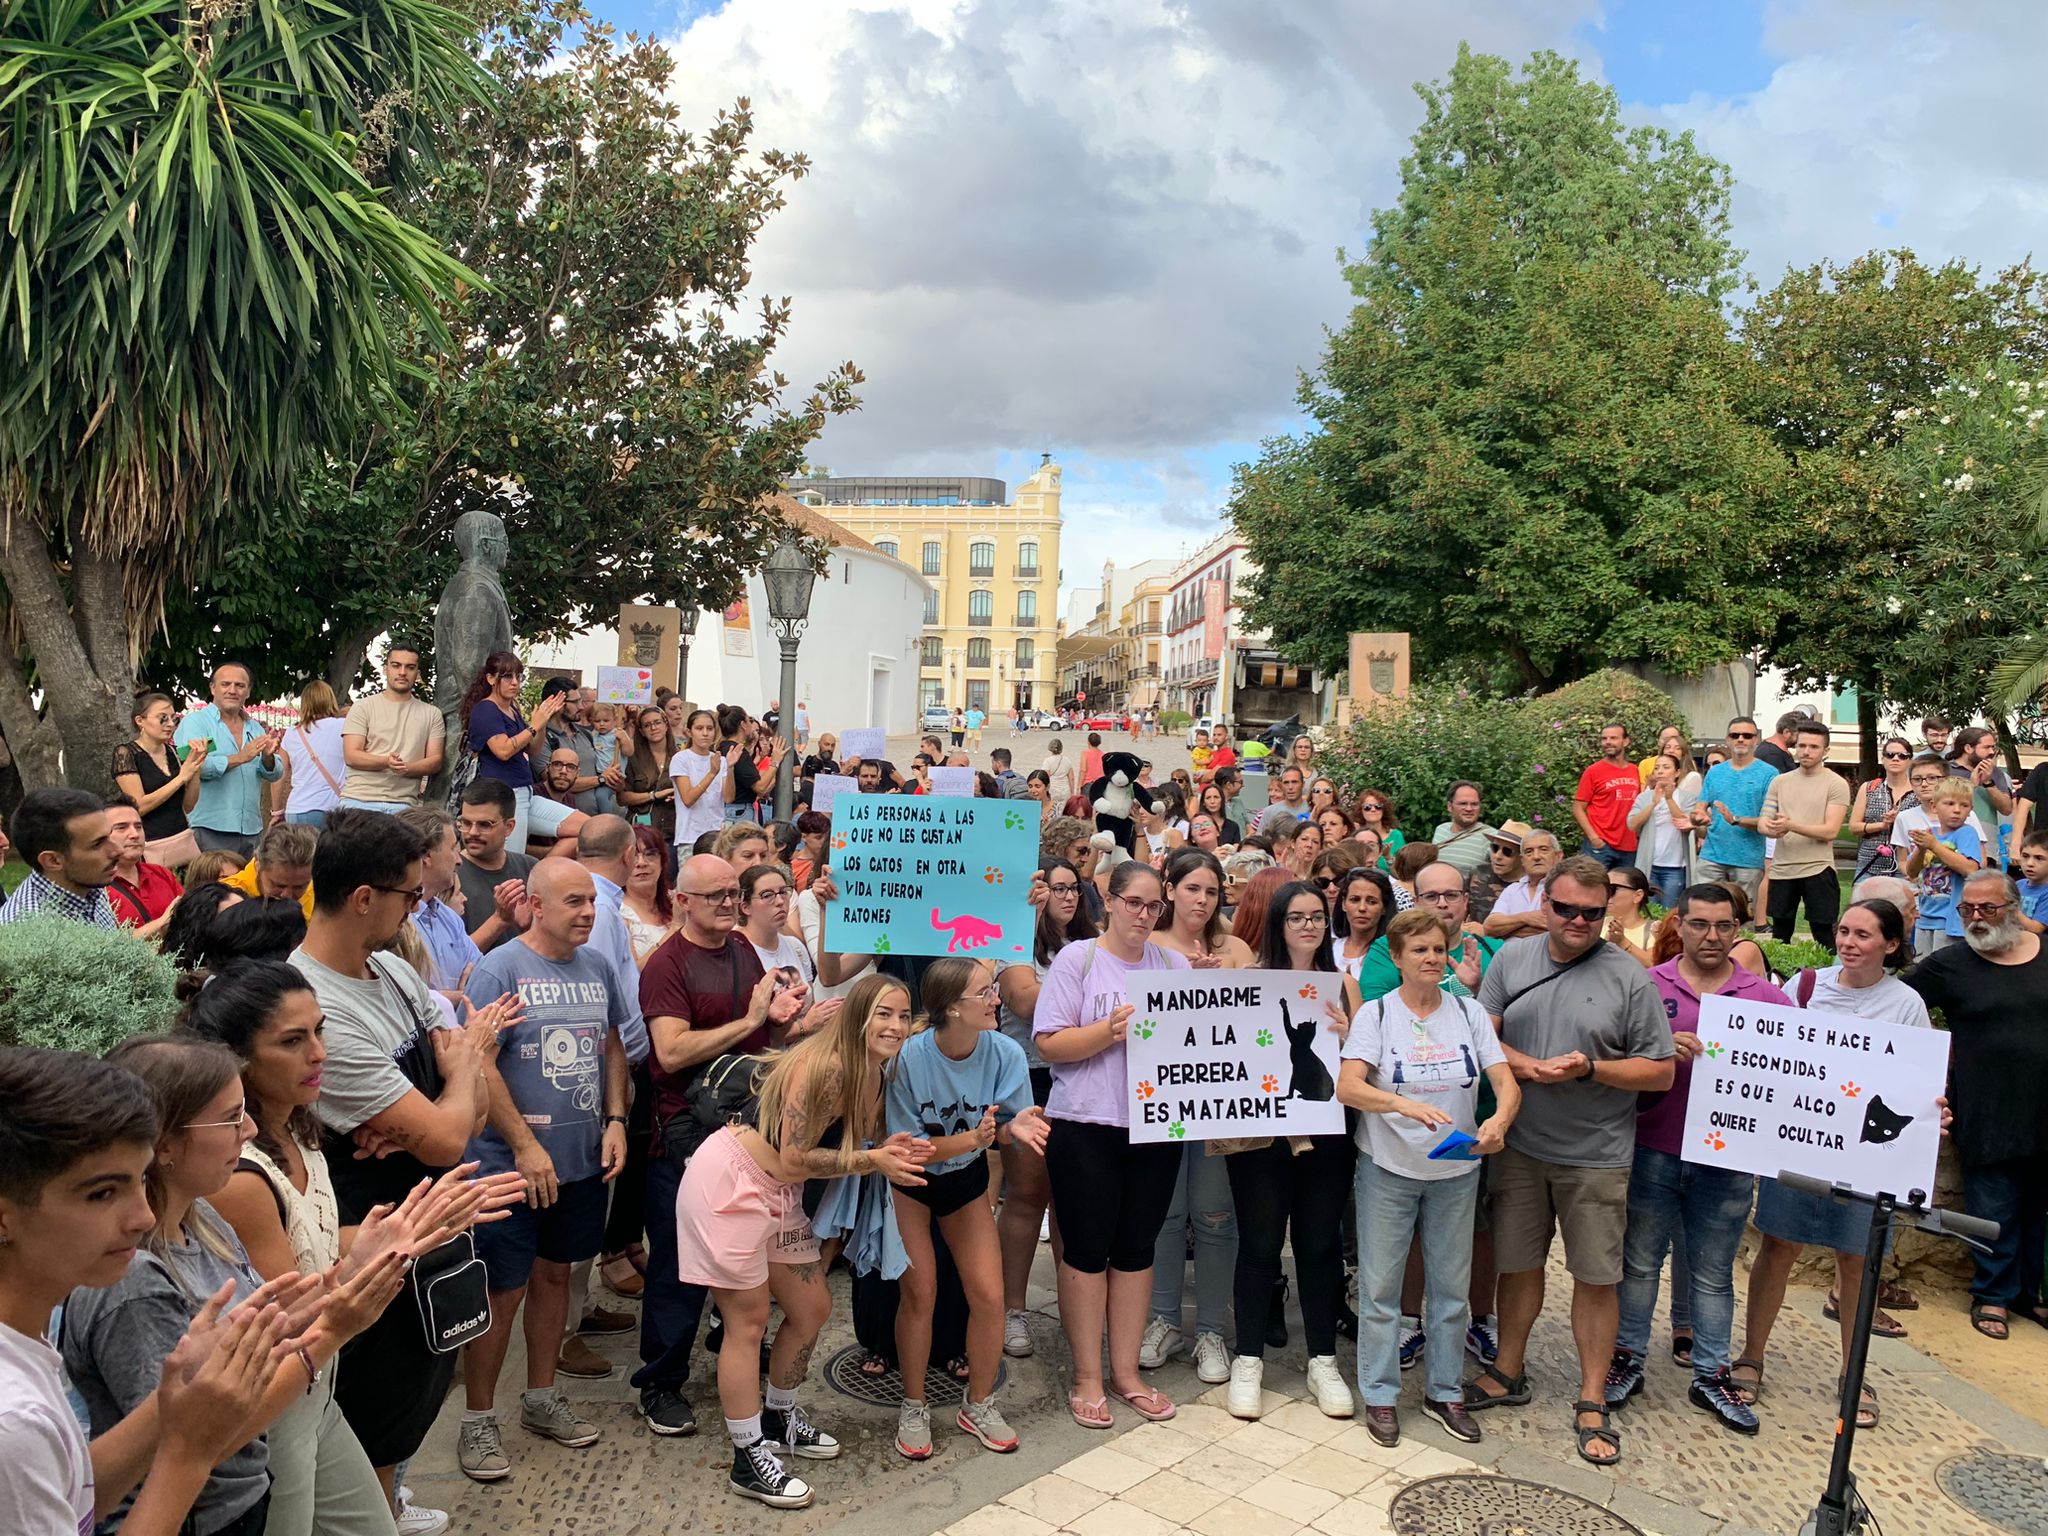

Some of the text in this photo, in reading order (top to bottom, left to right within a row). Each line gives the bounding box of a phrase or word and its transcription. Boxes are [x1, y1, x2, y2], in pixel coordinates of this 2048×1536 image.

[850, 806, 974, 825] LAS PERSONAS A LAS
[852, 827, 962, 844] QUE NO LES GUSTAN
[844, 856, 966, 875] LOS GATOS EN OTRA
[846, 881, 922, 899] VIDA FUERON
[844, 908, 890, 924] RATONES
[518, 983, 560, 1006] KEEP
[562, 982, 578, 1004] IT
[1148, 987, 1261, 1012] MANDARME
[1092, 991, 1127, 1022] MA
[1184, 1025, 1236, 1046] A LA
[1728, 1015, 1894, 1054] LO QUE SE HACE A
[1158, 1061, 1248, 1085] PERRERA
[1731, 1050, 1826, 1080] ESCONDIDAS
[1144, 1096, 1287, 1123] ES MATARME
[1716, 1079, 1835, 1116] ES QUE ALGO
[1710, 1111, 1843, 1150] QUIERE OCULTAR
[442, 1318, 478, 1338] adidas
